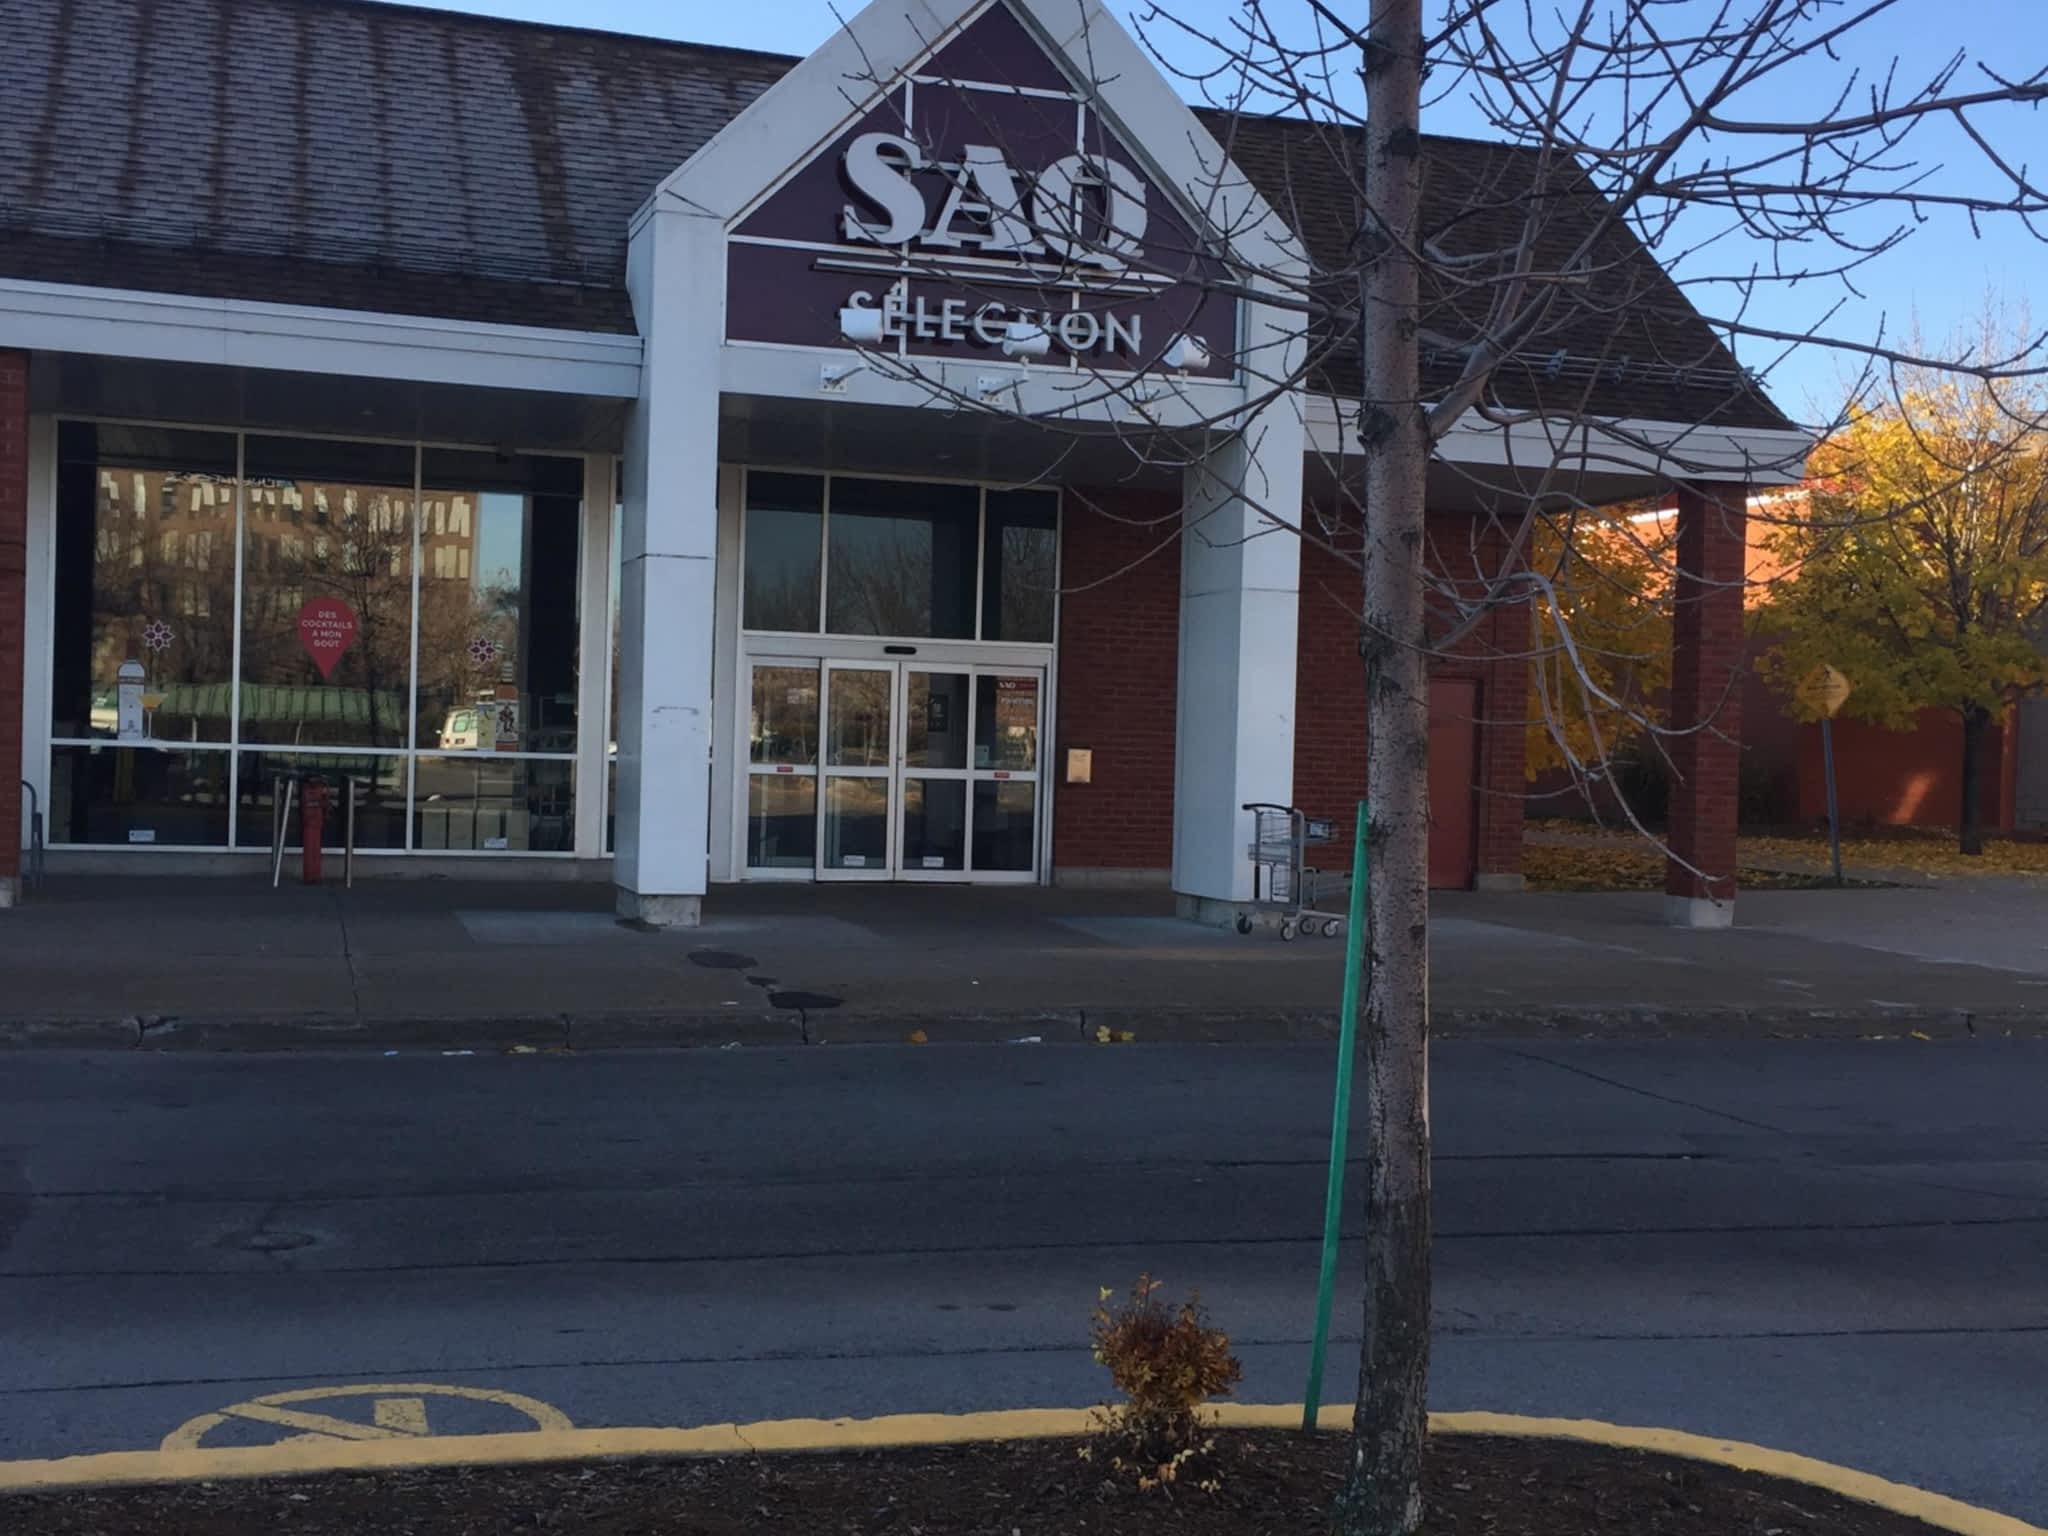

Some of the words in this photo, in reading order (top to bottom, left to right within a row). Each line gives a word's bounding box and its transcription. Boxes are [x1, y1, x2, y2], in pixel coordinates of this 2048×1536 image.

[843, 132, 1147, 270] SAQ
[318, 610, 337, 619] DES
[302, 620, 353, 629] COCKTAILS
[320, 630, 342, 638] MON
